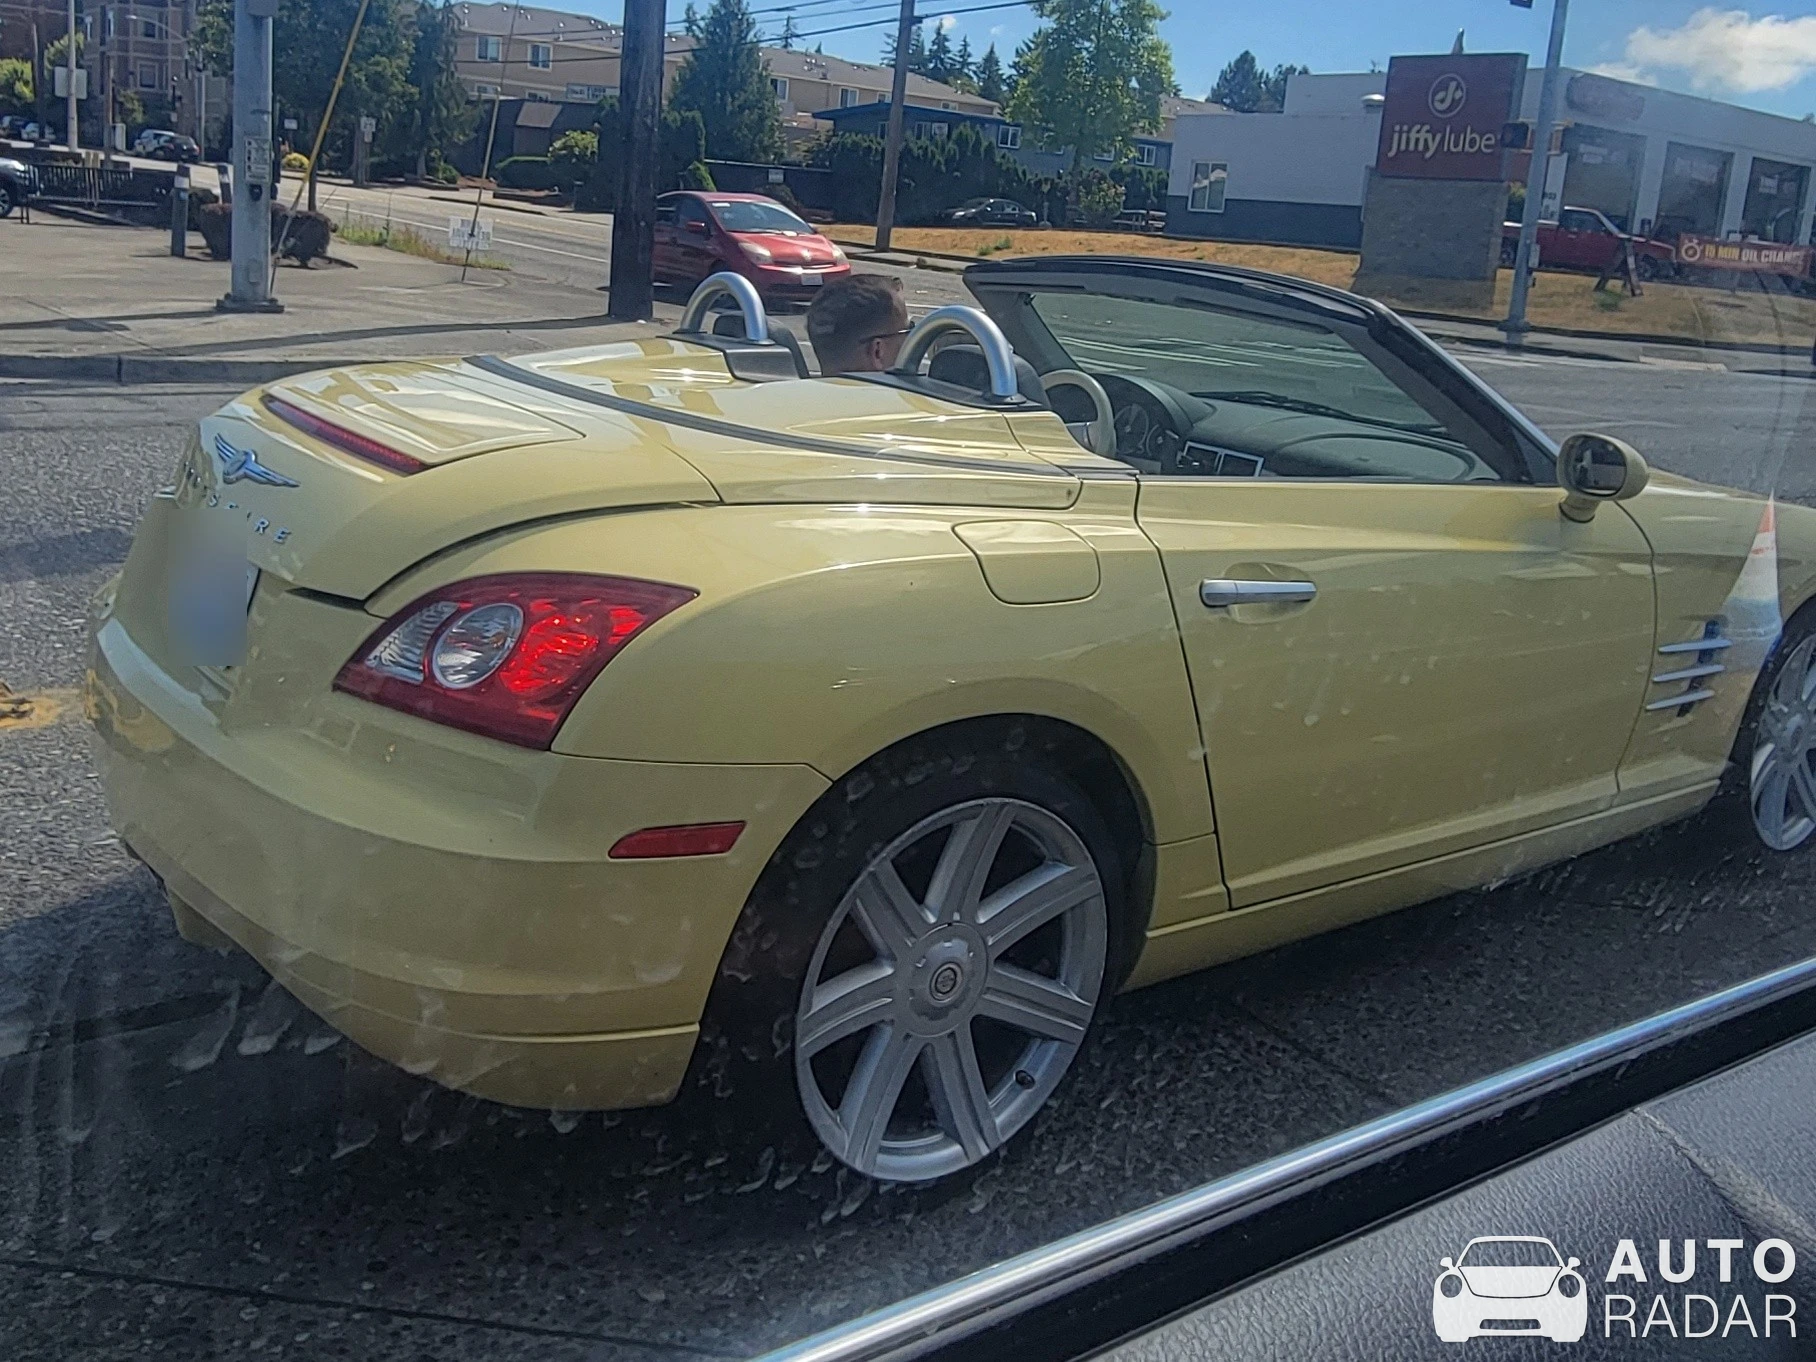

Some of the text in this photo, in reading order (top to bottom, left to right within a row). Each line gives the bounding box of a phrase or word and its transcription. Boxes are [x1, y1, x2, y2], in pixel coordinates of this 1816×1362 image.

[1387, 124, 1497, 160] jiffy lube
[1741, 248, 1758, 262] OIL
